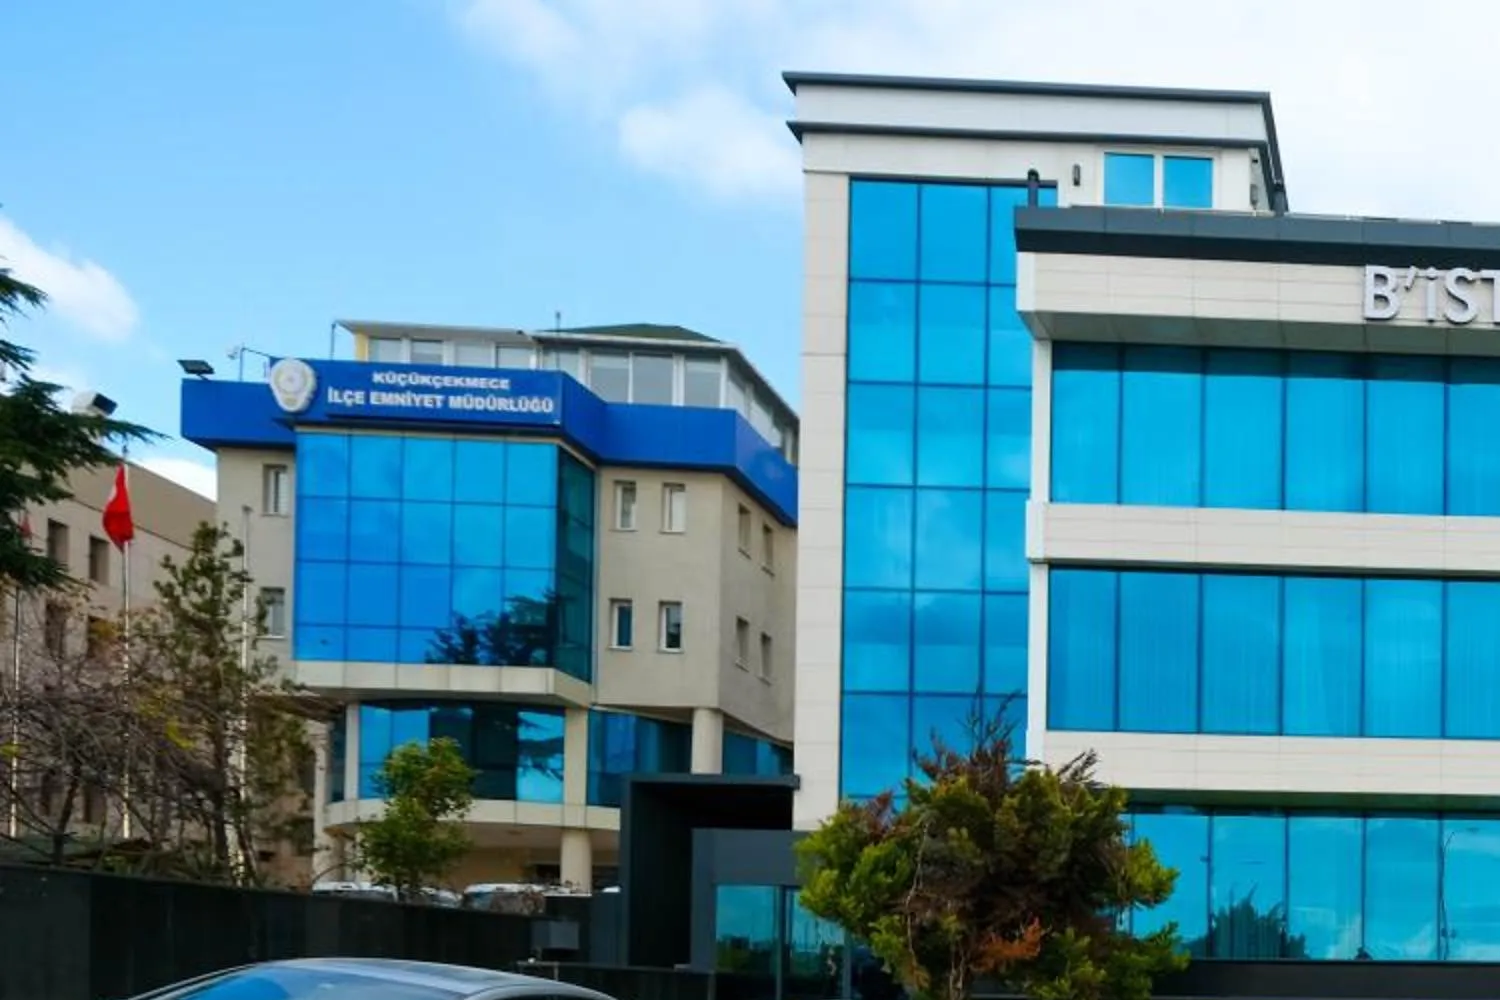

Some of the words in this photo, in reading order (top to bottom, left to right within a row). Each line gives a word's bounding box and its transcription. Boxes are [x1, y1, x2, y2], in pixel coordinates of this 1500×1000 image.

[372, 370, 511, 390] KÜÇÜKÇEKMECE
[327, 386, 365, 405] İLÇE
[370, 389, 444, 409] EMNİYET
[448, 393, 554, 413] MÜDÜRLÜĞÜ
